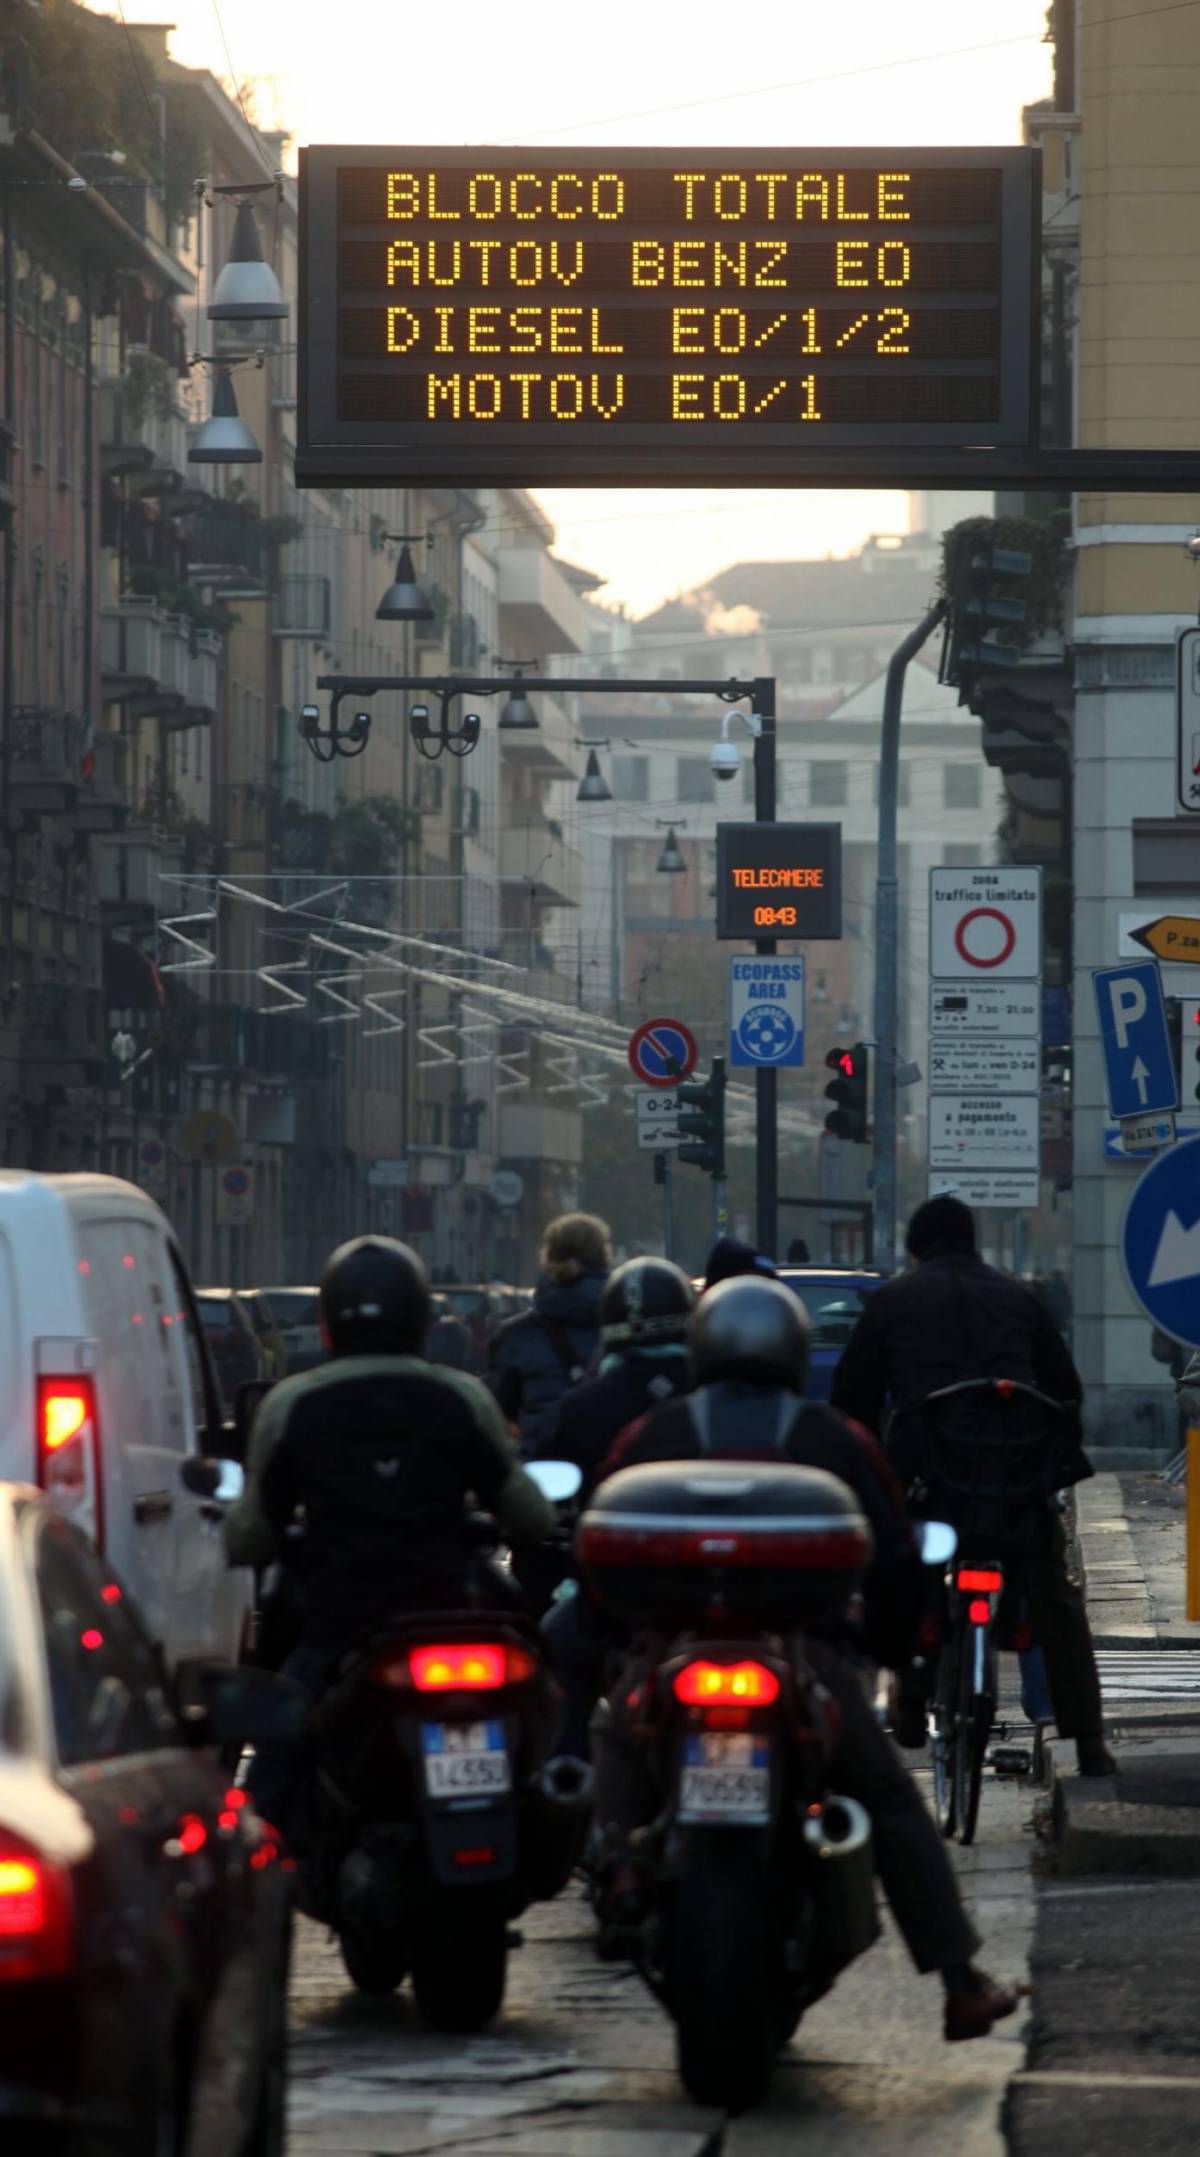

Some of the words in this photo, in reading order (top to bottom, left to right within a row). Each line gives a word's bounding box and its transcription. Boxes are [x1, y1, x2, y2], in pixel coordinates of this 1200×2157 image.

[387, 173, 624, 220] BLOCCO
[673, 173, 910, 220] TOTALE
[387, 240, 583, 287] AUTOV
[632, 240, 787, 287] BENZ
[387, 307, 624, 353] DIESEL
[428, 373, 624, 420] MOTOV
[732, 868, 824, 888] TELECAMERE
[935, 888, 982, 901] traffico
[986, 888, 1036, 901] limitato
[733, 964, 801, 981] ECOPASS
[748, 982, 786, 998] AREA
[1109, 977, 1148, 1049] P
[646, 1098, 683, 1112] 0-24
